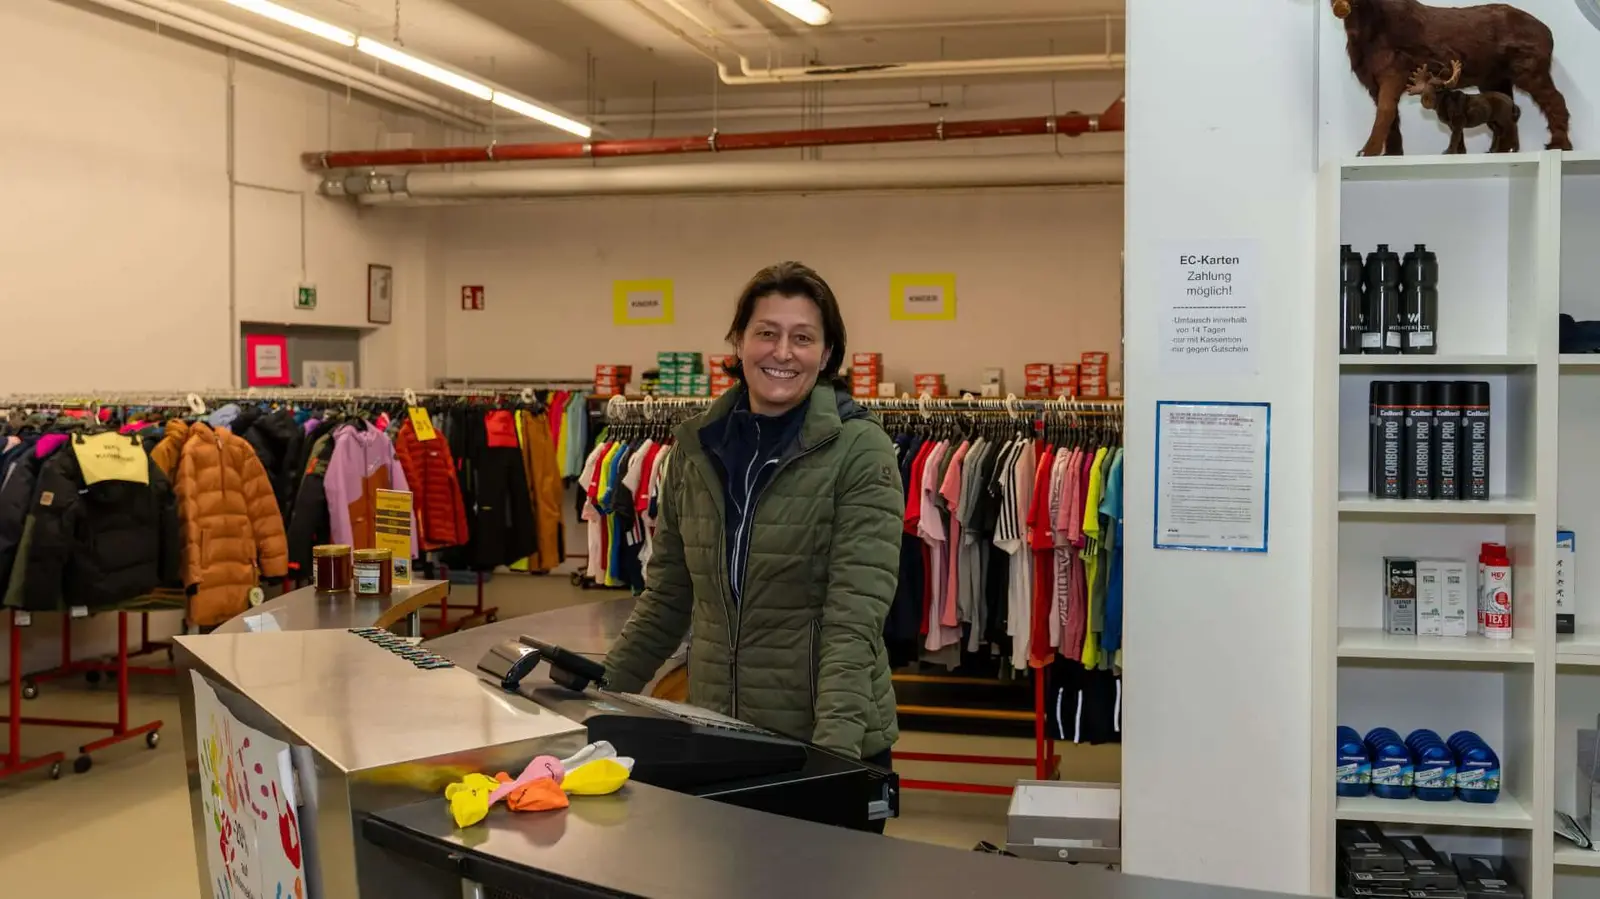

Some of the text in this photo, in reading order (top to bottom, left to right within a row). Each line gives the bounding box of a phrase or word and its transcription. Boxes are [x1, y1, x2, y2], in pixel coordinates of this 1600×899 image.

[1180, 255, 1240, 265] EC-Karten
[1187, 271, 1232, 282] Zahlung
[1186, 286, 1232, 298] möglich!
[1385, 421, 1398, 476] CARBON PRO
[1416, 422, 1428, 477] CARBON PRO
[1442, 422, 1454, 477] CARBON PRO
[1472, 422, 1485, 477] CARBON PRO
[1491, 572, 1506, 580] HEY
[1488, 614, 1503, 624] TEX
